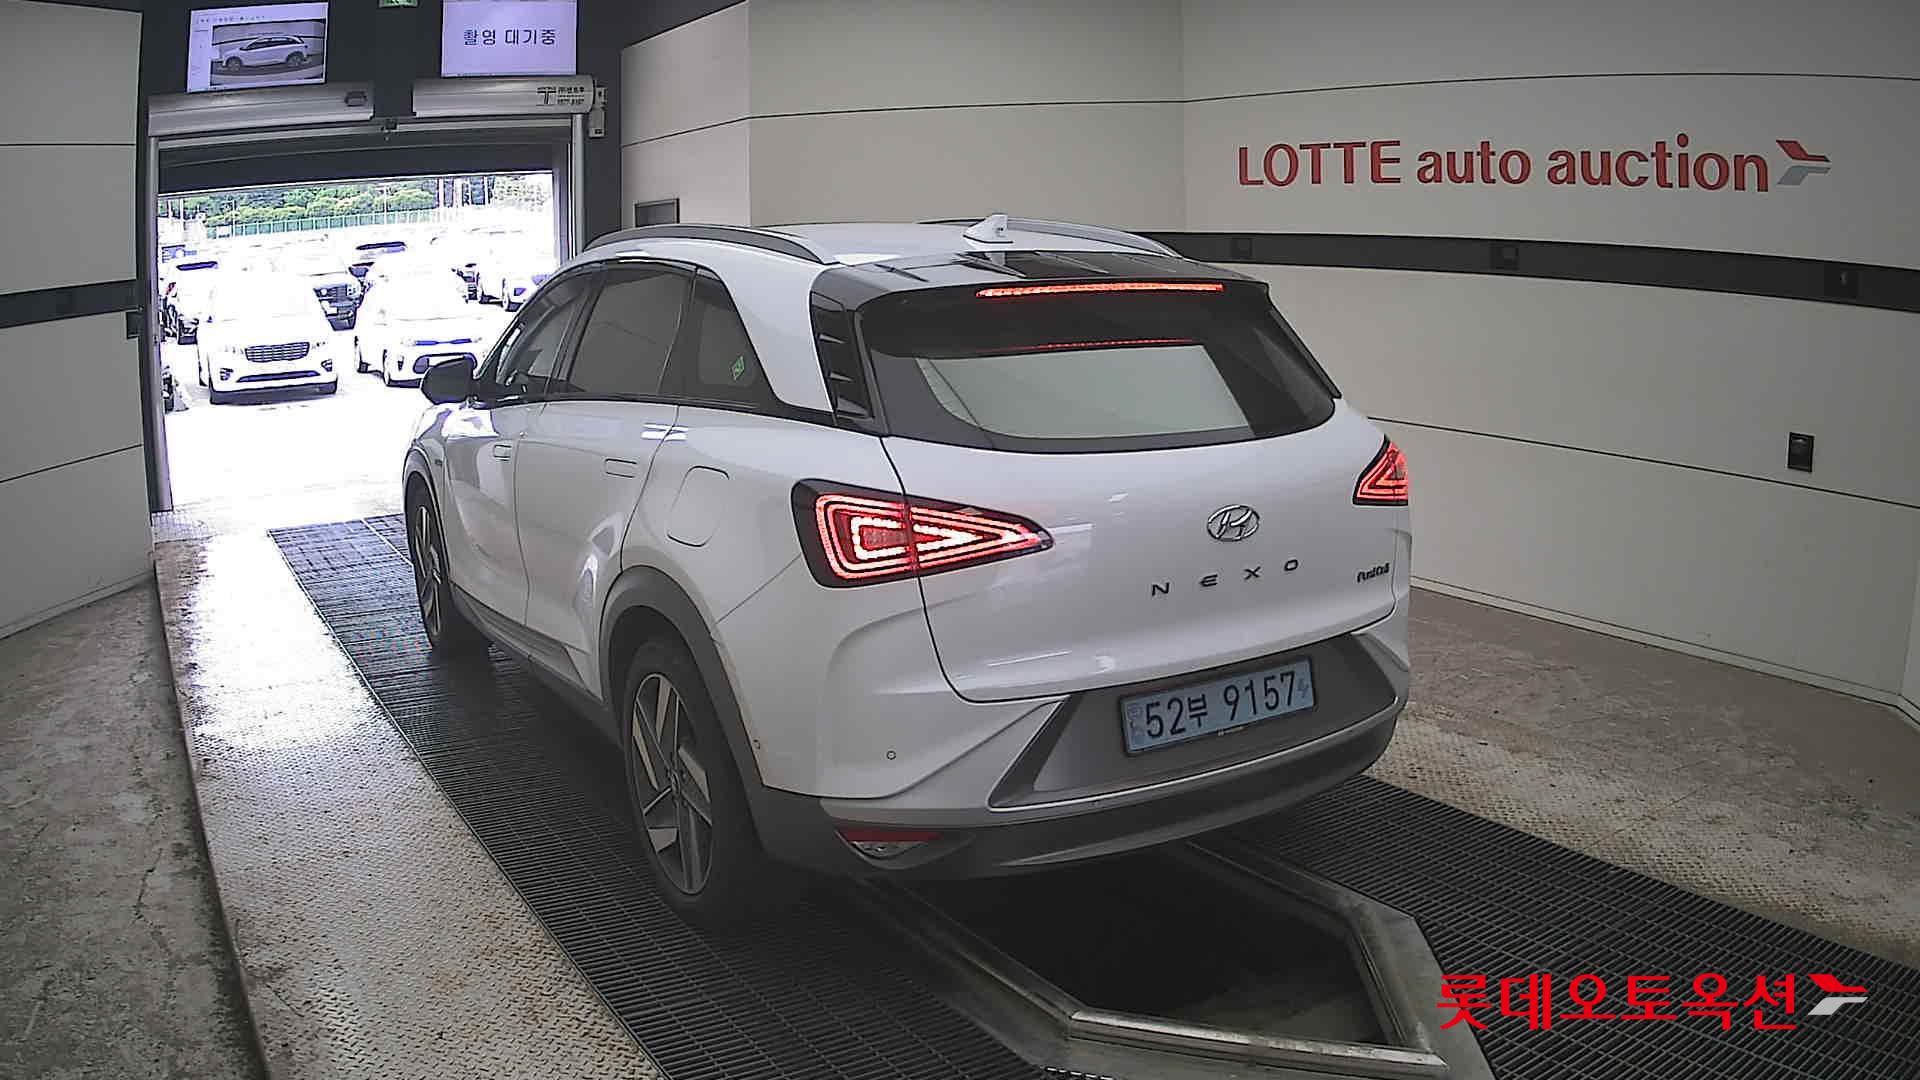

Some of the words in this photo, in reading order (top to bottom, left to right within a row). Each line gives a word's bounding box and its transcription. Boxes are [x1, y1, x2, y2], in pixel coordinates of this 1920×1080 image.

[463, 28, 497, 46] 촬영
[504, 28, 556, 46] 대기중
[1239, 140, 1400, 187] LOTTE
[1416, 140, 1532, 185] auto
[1547, 133, 1769, 192] auction
[1151, 558, 1300, 598] NEXO
[1145, 692, 1209, 739] 52부
[1222, 670, 1296, 722] 9157
